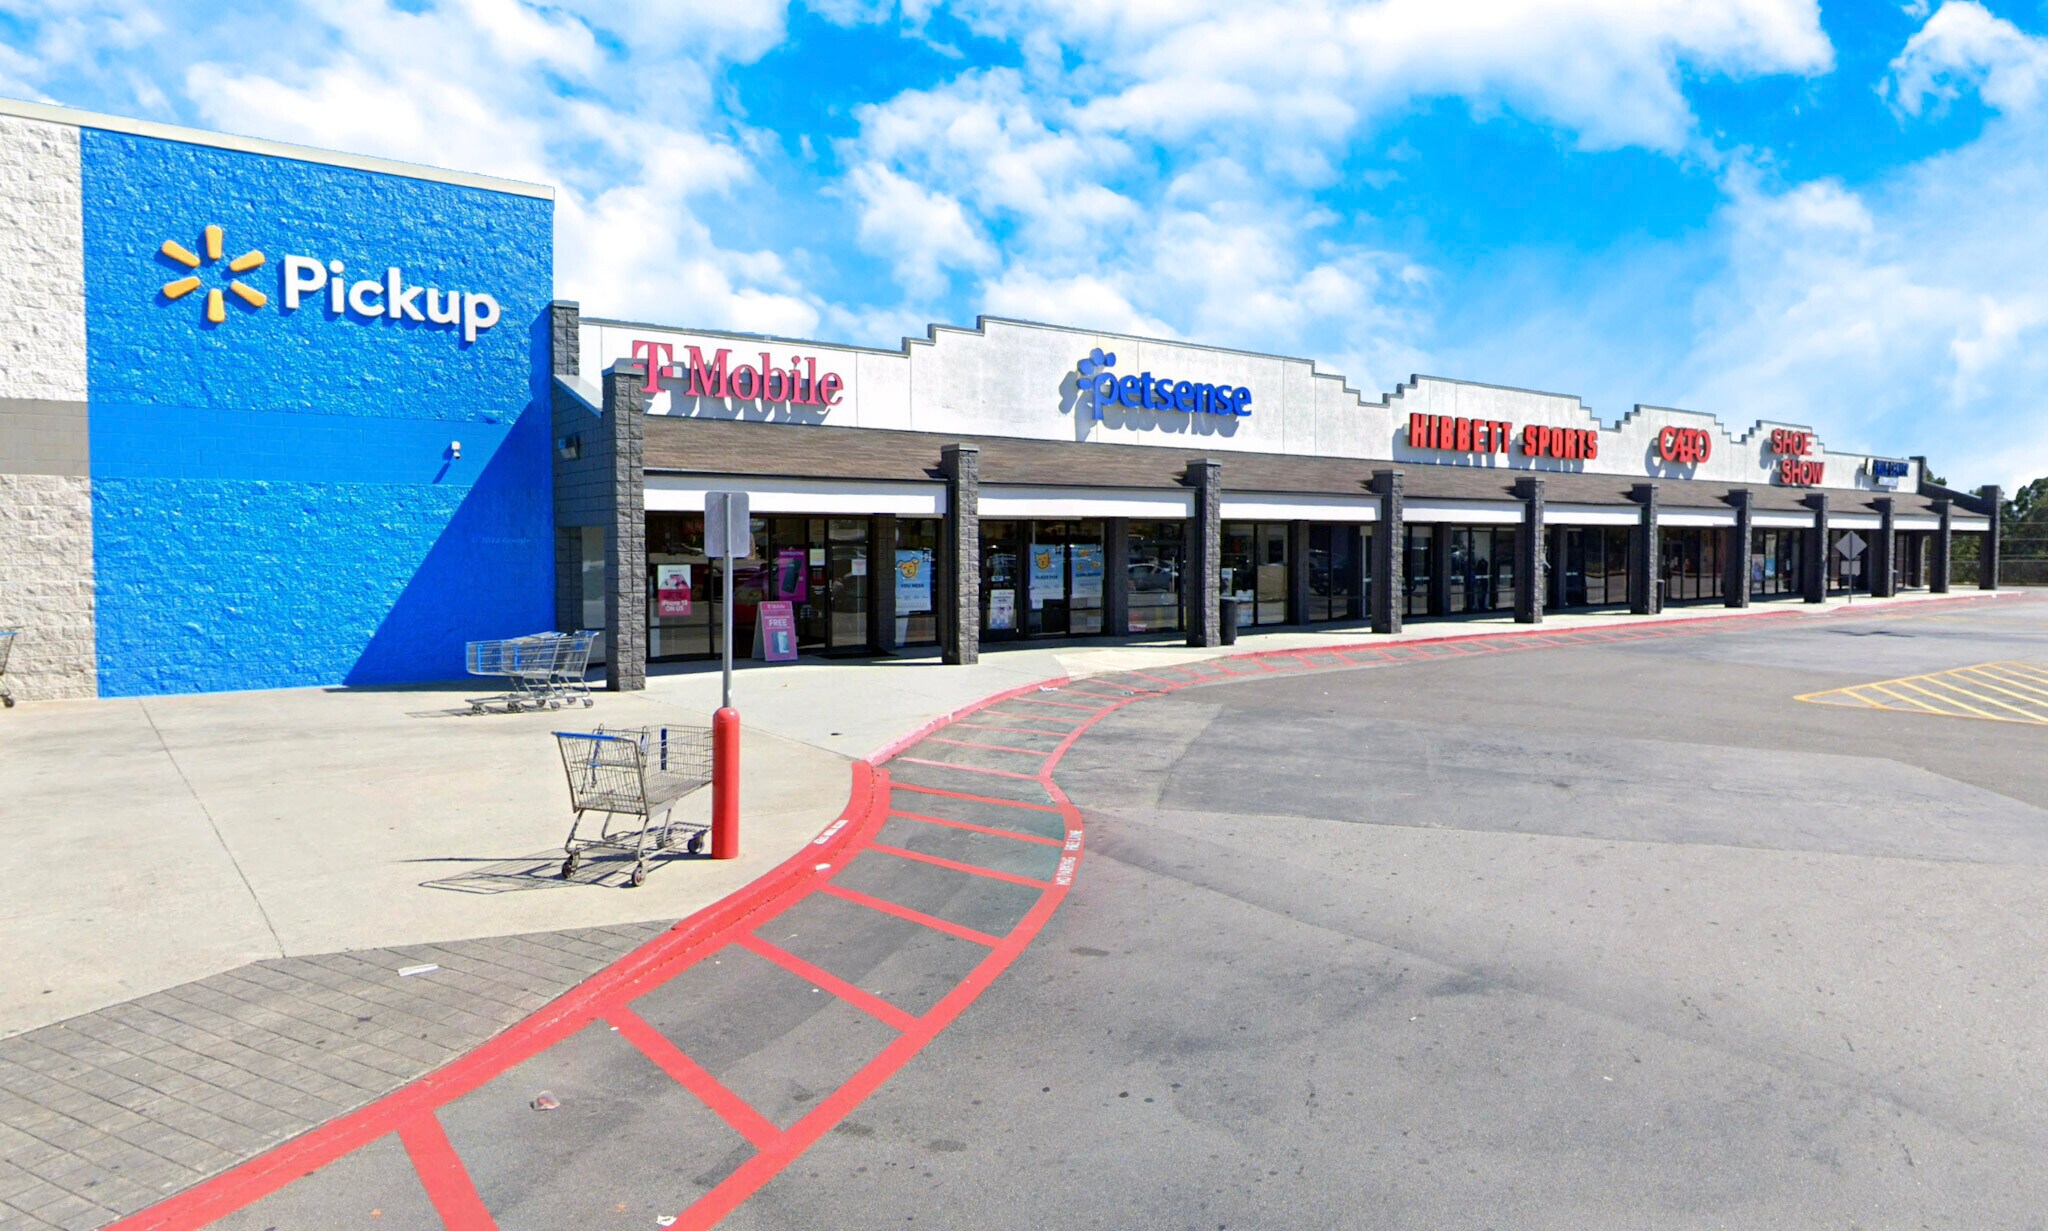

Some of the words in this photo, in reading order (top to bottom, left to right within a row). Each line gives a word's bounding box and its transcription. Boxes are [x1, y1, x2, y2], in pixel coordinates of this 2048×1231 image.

[285, 254, 500, 342] Pickup
[631, 340, 844, 406] T-Mobile
[1092, 371, 1252, 421] petsense
[1410, 412, 1513, 454] HIBBETT
[1523, 424, 1598, 460] SPORTS
[1659, 425, 1711, 463] CATO
[1771, 428, 1813, 456] SHOE
[1781, 459, 1825, 486] SHOW
[769, 618, 788, 627] FREE
